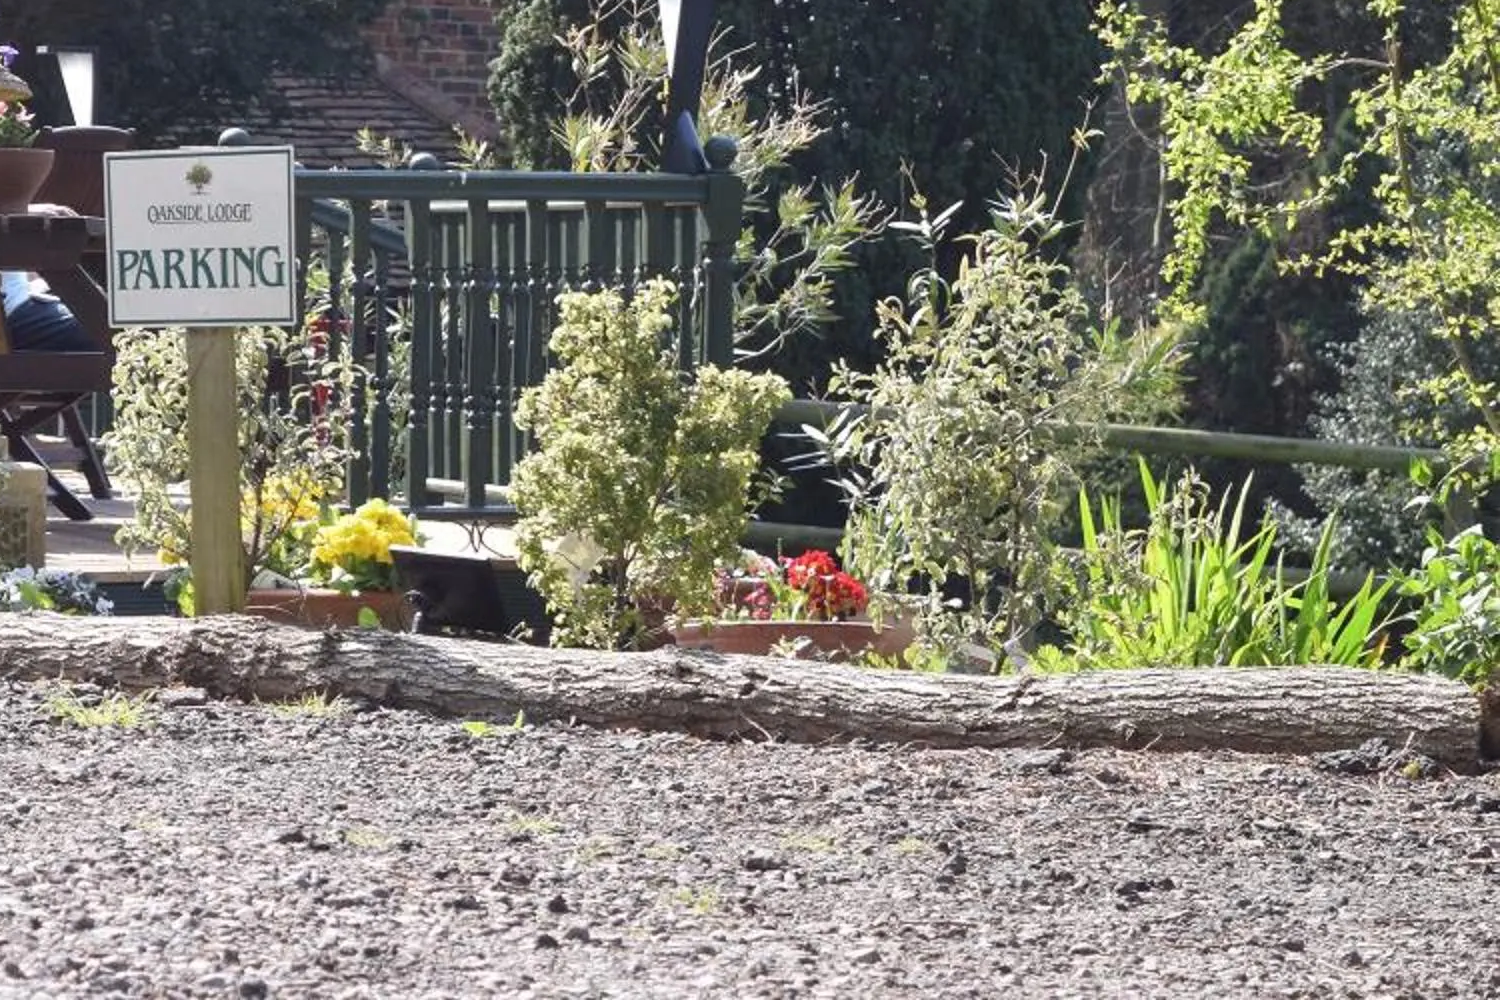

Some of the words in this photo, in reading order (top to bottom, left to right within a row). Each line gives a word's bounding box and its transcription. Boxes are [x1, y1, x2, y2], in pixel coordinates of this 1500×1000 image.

[147, 204, 203, 224] OAKSIDE
[207, 203, 252, 223] LODGE
[116, 245, 286, 290] PARKING
